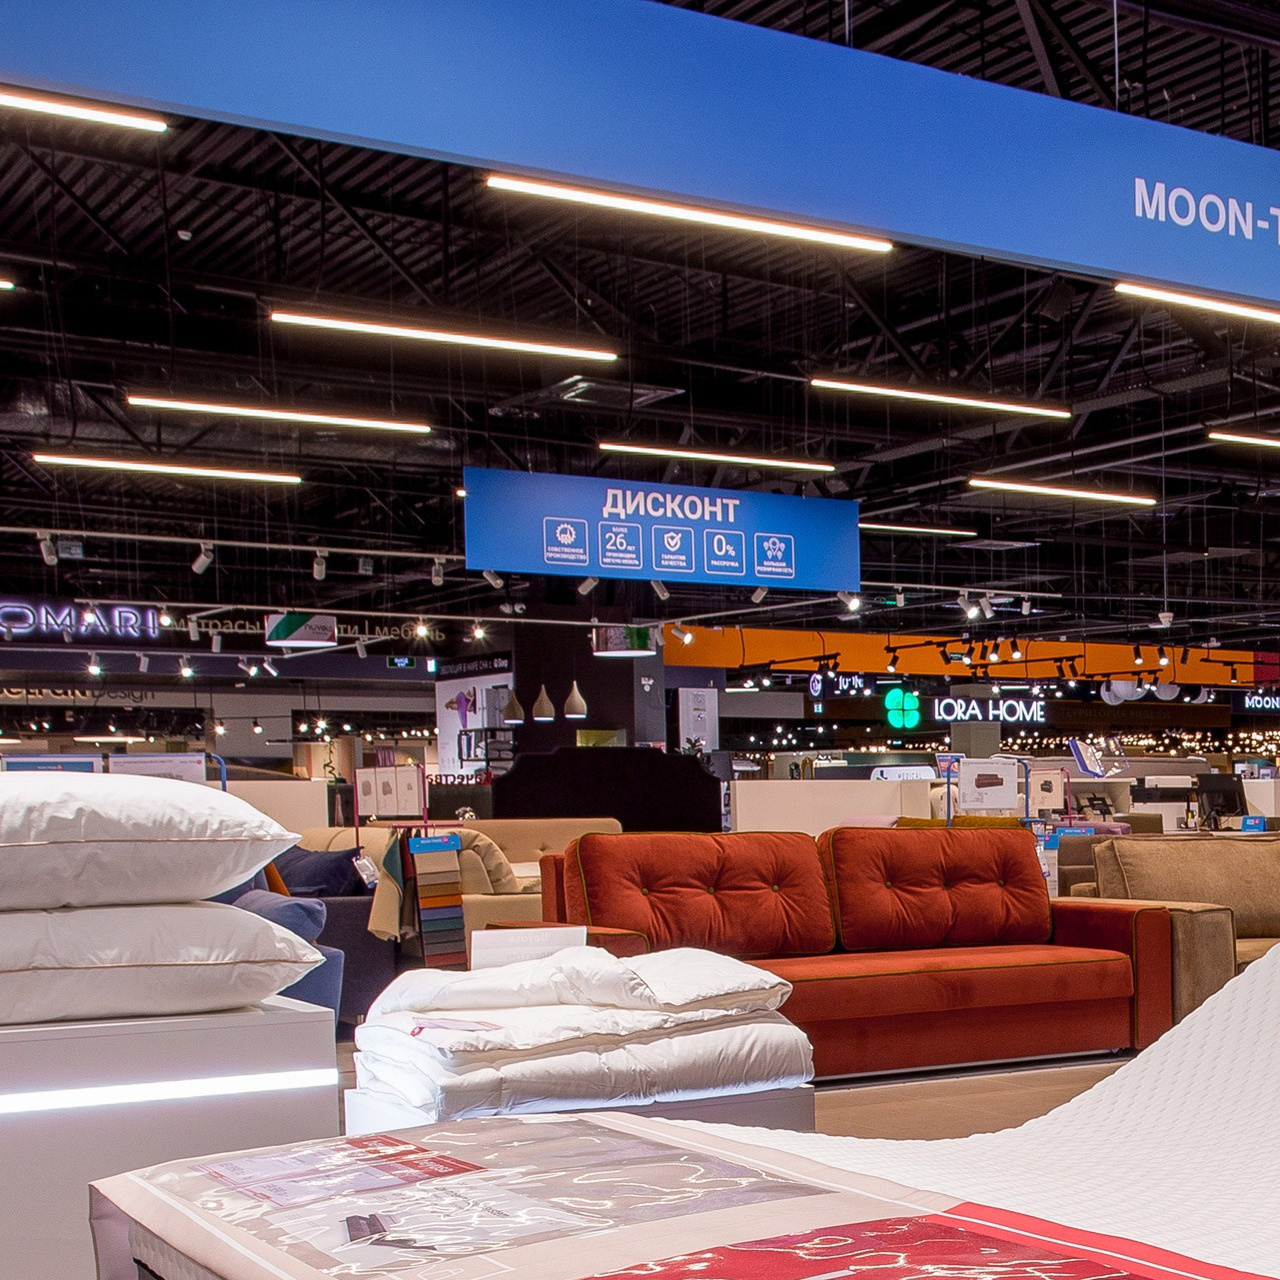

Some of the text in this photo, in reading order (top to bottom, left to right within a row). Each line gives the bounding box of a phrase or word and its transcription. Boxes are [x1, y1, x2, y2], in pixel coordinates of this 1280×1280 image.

[602, 488, 740, 523] ДИСКОНТ
[605, 532, 627, 550] 26
[661, 553, 687, 561] ГАРАНТИЯ
[661, 559, 688, 567] КАЧЕСТВА
[711, 559, 740, 568] РАССРОЧКА
[934, 698, 1046, 722] LORA HOME
